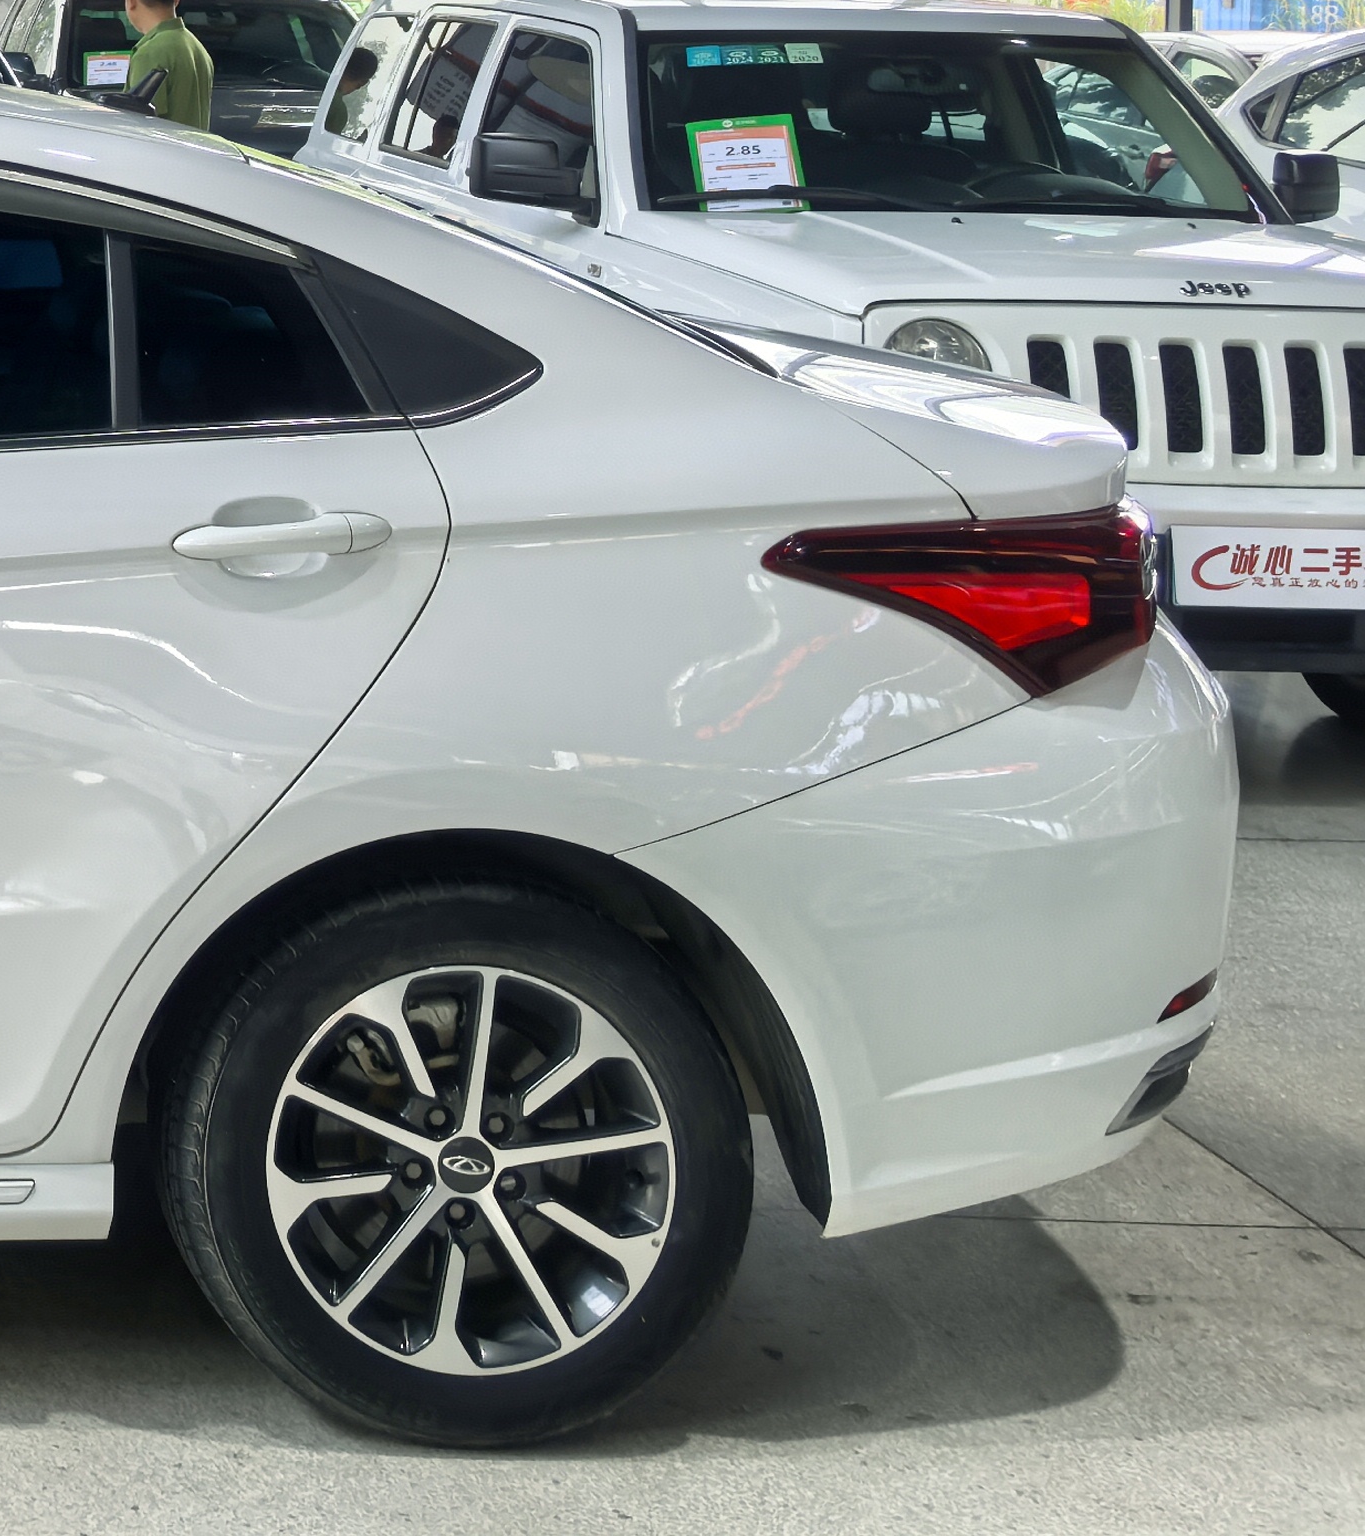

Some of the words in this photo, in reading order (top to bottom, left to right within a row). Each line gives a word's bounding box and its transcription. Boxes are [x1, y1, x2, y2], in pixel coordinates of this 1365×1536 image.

[725, 144, 761, 156] 2.85
[1179, 280, 1251, 298] Jeep
[1230, 543, 1365, 576] 诚心二手
